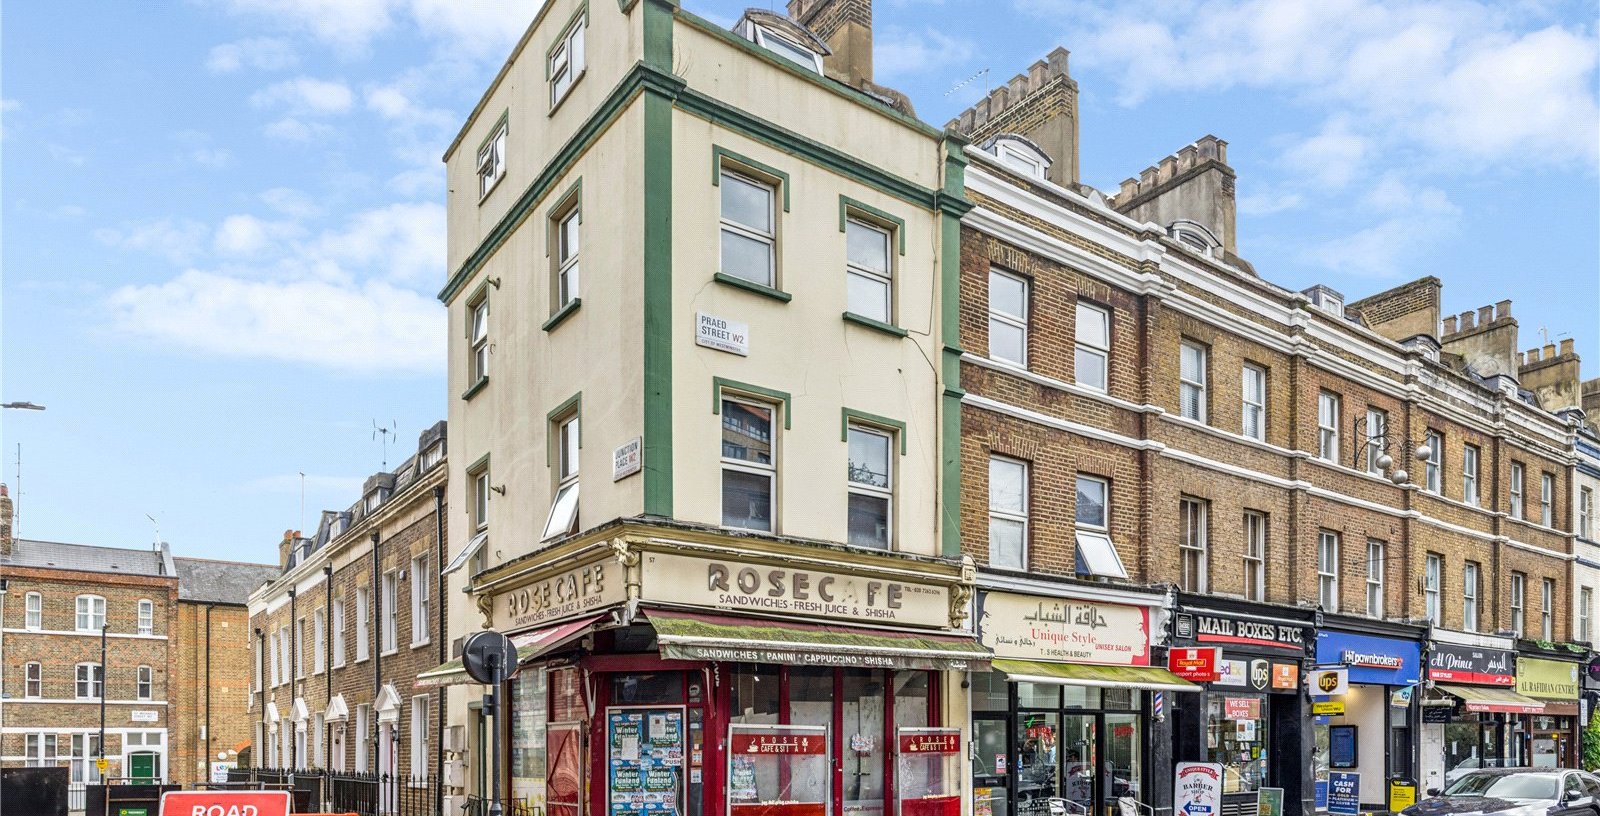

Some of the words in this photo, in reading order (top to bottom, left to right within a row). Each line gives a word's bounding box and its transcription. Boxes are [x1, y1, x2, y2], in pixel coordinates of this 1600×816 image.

[701, 315, 727, 330] PRAED
[701, 326, 730, 340] STREET
[732, 333, 744, 344] W2
[615, 441, 638, 460] JUNCTION
[615, 456, 628, 469] PLACE
[628, 452, 636, 463] W2
[508, 580, 551, 618] ROSE
[556, 564, 604, 604] CAFE
[708, 562, 810, 600] ROSE
[818, 576, 903, 609] CFE
[515, 611, 545, 626] SANDWICHES
[546, 607, 561, 618] FRESH
[561, 602, 575, 616] JUICE
[583, 595, 602, 608] SHISHA
[720, 594, 788, 609] SANDWICHES
[794, 600, 822, 611] FRESH
[824, 603, 848, 615] JUICE
[852, 607, 859, 616] &
[865, 608, 896, 619] SHISHA
[1022, 602, 1071, 628] الشباب
[1075, 604, 1107, 630] حلاقة
[1197, 616, 1233, 636] MAIL
[1237, 621, 1275, 640] BOXES
[1031, 628, 1069, 644] Unique
[1071, 631, 1097, 647] Style
[1051, 649, 1069, 657] HEALTH
[1095, 643, 1114, 651] UNISEX
[1115, 644, 1132, 652] SALON
[697, 648, 758, 660] SANDWICHES
[766, 652, 796, 661] PANINI
[804, 654, 857, 664] CAPPUCCINO
[864, 656, 894, 666] SHISHA
[1445, 653, 1473, 670] Prince
[1252, 668, 1268, 686] ups
[1319, 677, 1337, 690] ups
[1521, 681, 1528, 692] AL
[1555, 684, 1575, 695] CENTRE
[616, 726, 638, 734] Winter
[760, 736, 798, 744] ROSE
[760, 745, 774, 753] CAFE
[615, 777, 640, 785] Funland
[616, 770, 639, 778] Winter
[647, 777, 672, 785] Funland
[648, 770, 671, 778] Winter
[1183, 783, 1214, 792] BARBER
[1333, 780, 1354, 788] CASH
[191, 804, 258, 816] ROAD
